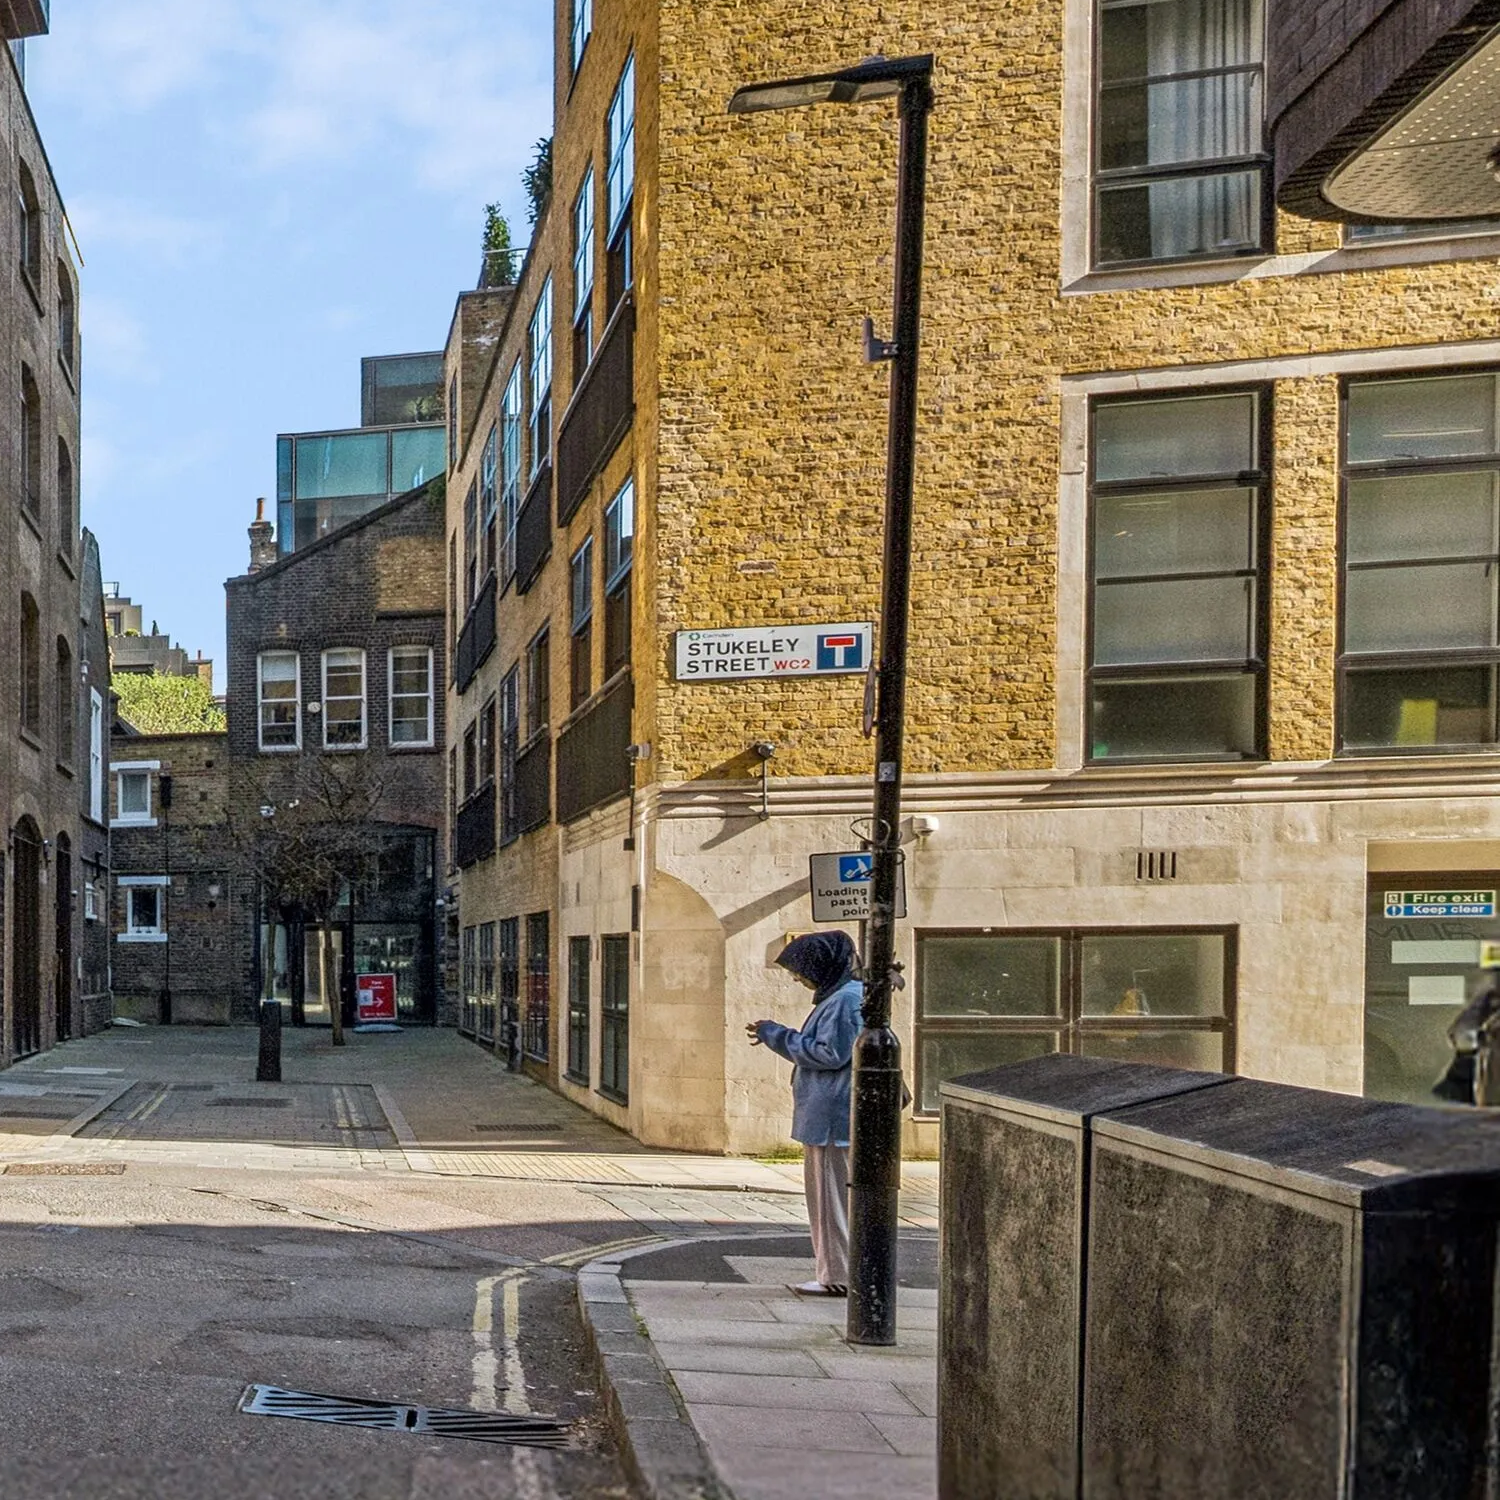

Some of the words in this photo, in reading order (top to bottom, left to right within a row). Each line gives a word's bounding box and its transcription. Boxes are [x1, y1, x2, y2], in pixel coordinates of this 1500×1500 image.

[688, 638, 799, 656] STUKELEY
[687, 657, 770, 674] STREET
[774, 659, 810, 671] WC2
[818, 887, 867, 897] Loading
[831, 897, 858, 907] past
[1412, 893, 1447, 903] Fire
[1451, 893, 1486, 902] exit
[842, 907, 869, 917] poin
[1412, 905, 1446, 915] Keep
[1451, 904, 1485, 913] clear
